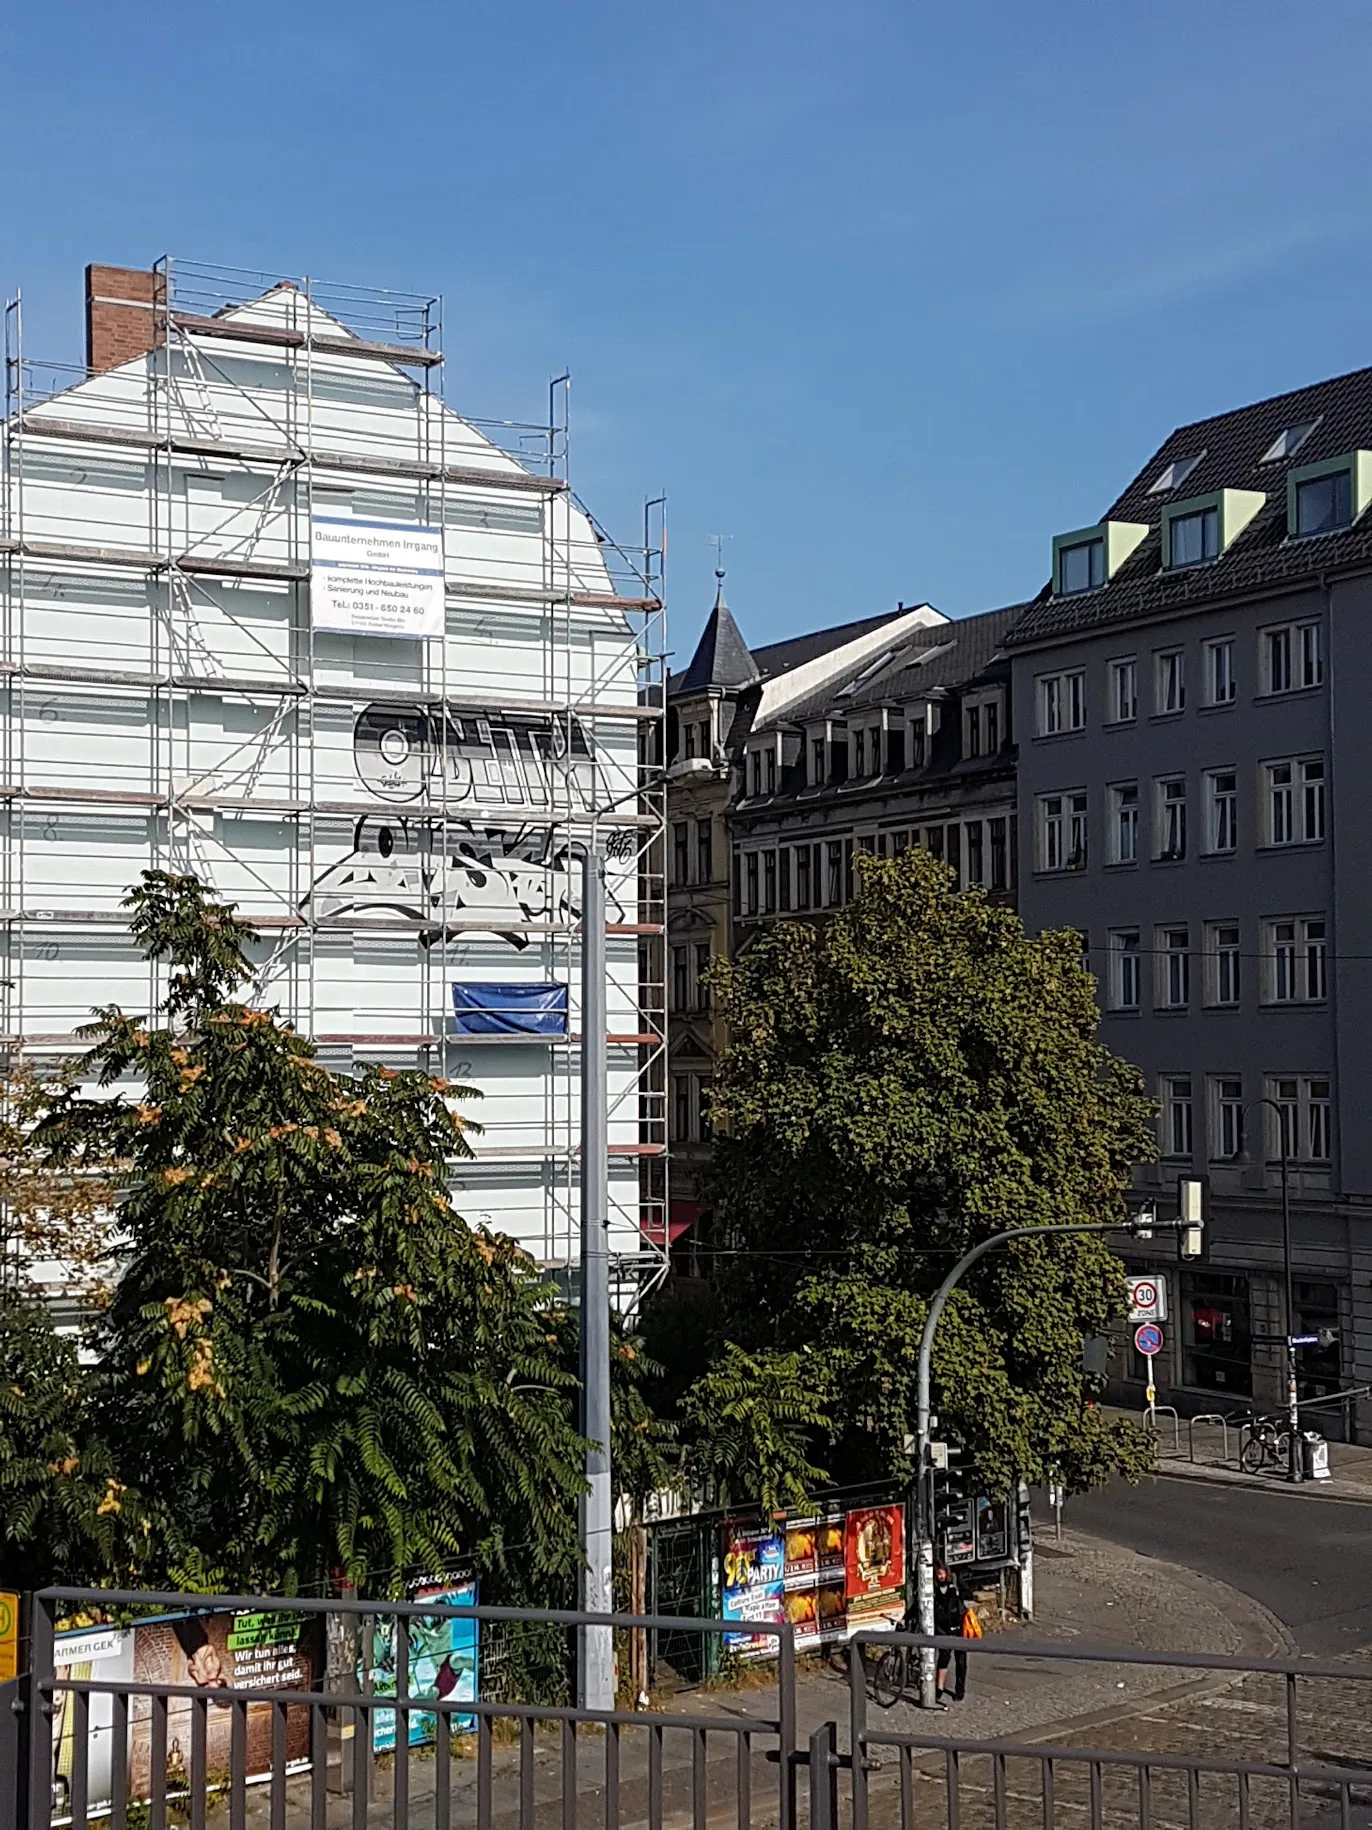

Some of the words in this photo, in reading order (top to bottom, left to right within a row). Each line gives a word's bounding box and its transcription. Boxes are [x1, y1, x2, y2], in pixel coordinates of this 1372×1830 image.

[315, 531, 401, 548] Bauunternehmen
[403, 540, 439, 553] Irrgang
[327, 584, 363, 596] Sanierung
[365, 588, 380, 596] und
[352, 601, 374, 611] 0351
[381, 604, 398, 613] 650
[400, 605, 411, 614] 24
[413, 606, 425, 615] 60
[1139, 1289, 1152, 1301] 30
[747, 1563, 779, 1584] PARTY
[237, 1618, 255, 1628] Tut,
[54, 1643, 92, 1657] ARMER
[93, 1640, 114, 1651] GEK
[234, 1650, 253, 1662] Wir
[254, 1648, 271, 1659] tun
[272, 1644, 297, 1656] alles,
[234, 1662, 261, 1676] damit
[263, 1660, 277, 1671] ihr
[277, 1657, 294, 1672] gut
[234, 1672, 280, 1689] versichert
[281, 1668, 303, 1682] seid.
